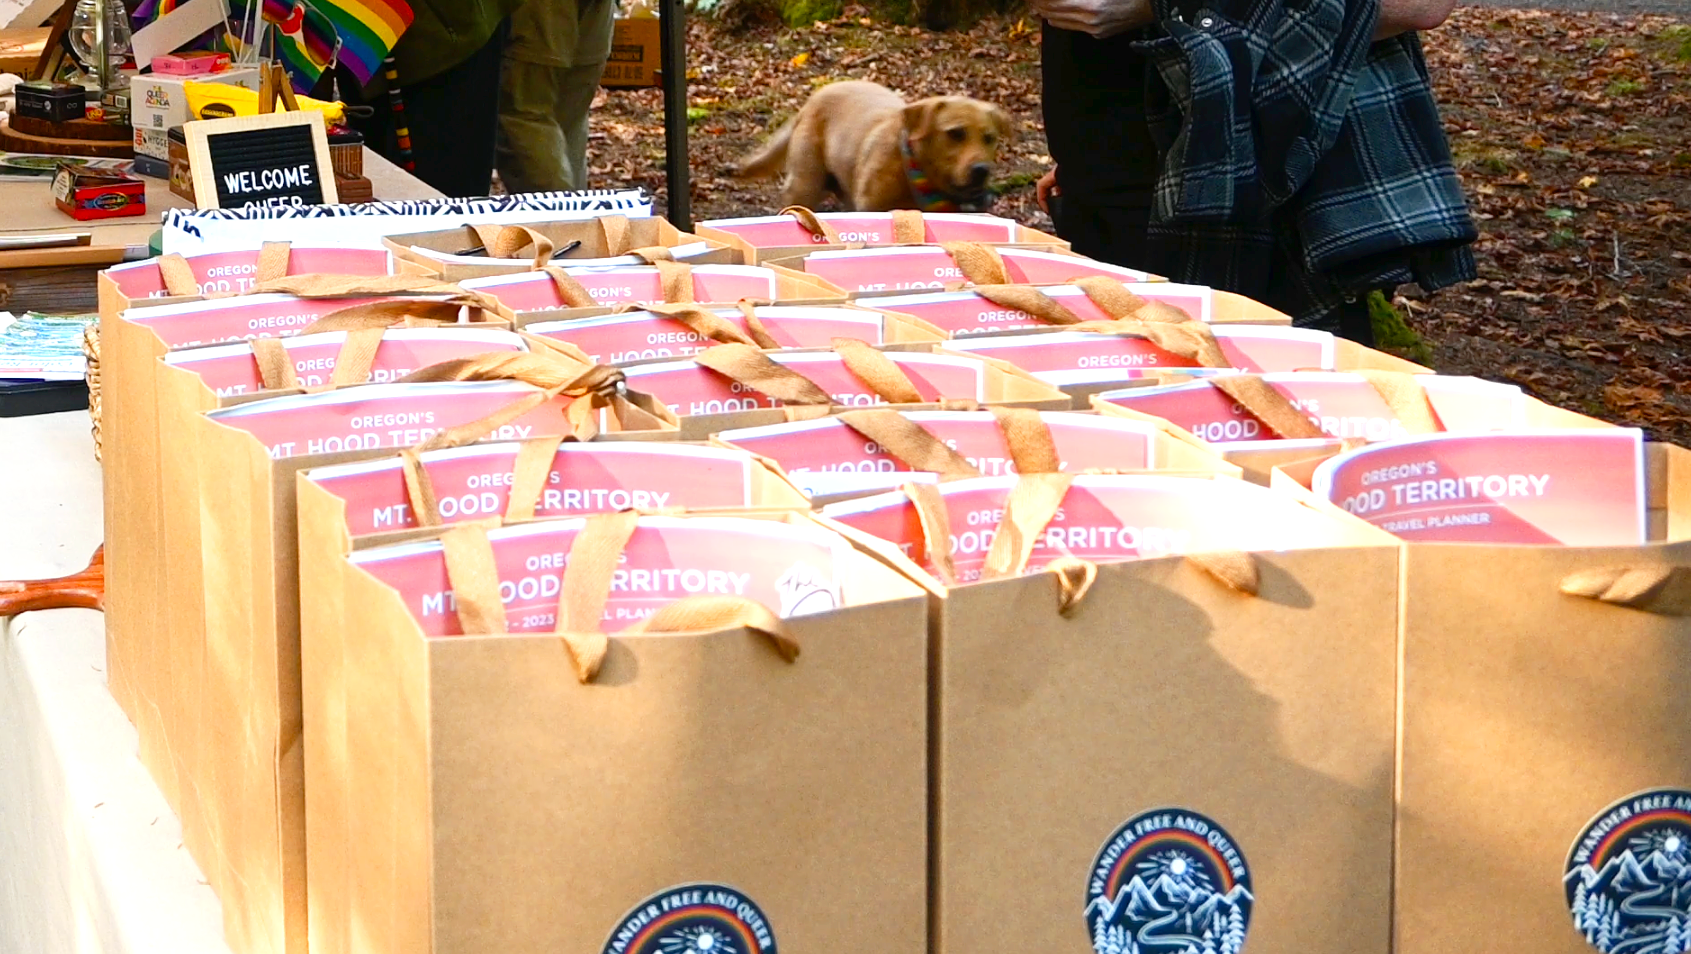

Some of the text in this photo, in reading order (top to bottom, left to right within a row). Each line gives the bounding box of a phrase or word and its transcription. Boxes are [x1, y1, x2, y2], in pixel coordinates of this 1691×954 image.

[224, 164, 313, 194] WELCOME
[207, 265, 257, 277] OREGON
[196, 279, 231, 295] OOD
[249, 314, 318, 329] OREGON'S
[978, 311, 1037, 322] OREGON
[647, 332, 708, 344] OREGON
[296, 358, 335, 372] OREG
[1078, 354, 1157, 368] OREGON'S
[690, 397, 757, 415] HOOD
[351, 412, 435, 429] OREGON'S
[1193, 419, 1259, 441] HOOD
[308, 434, 380, 455] HOOD
[1360, 460, 1437, 485] OREGON'S
[1343, 474, 1550, 514] OOD TERRITORY
[373, 505, 411, 527] MT.
[439, 492, 499, 517] OOD
[1427, 512, 1491, 527] PLANNER
[950, 529, 996, 554] OOD
[499, 574, 560, 603] OOD
[610, 569, 750, 595] RRITORY
[1573, 795, 1691, 862] WANDER FREE AN
[1090, 814, 1246, 894] WANDER FREE AND QUEER
[661, 890, 703, 911] FREE
[704, 890, 739, 910] AND
[736, 901, 772, 950] QUEER
